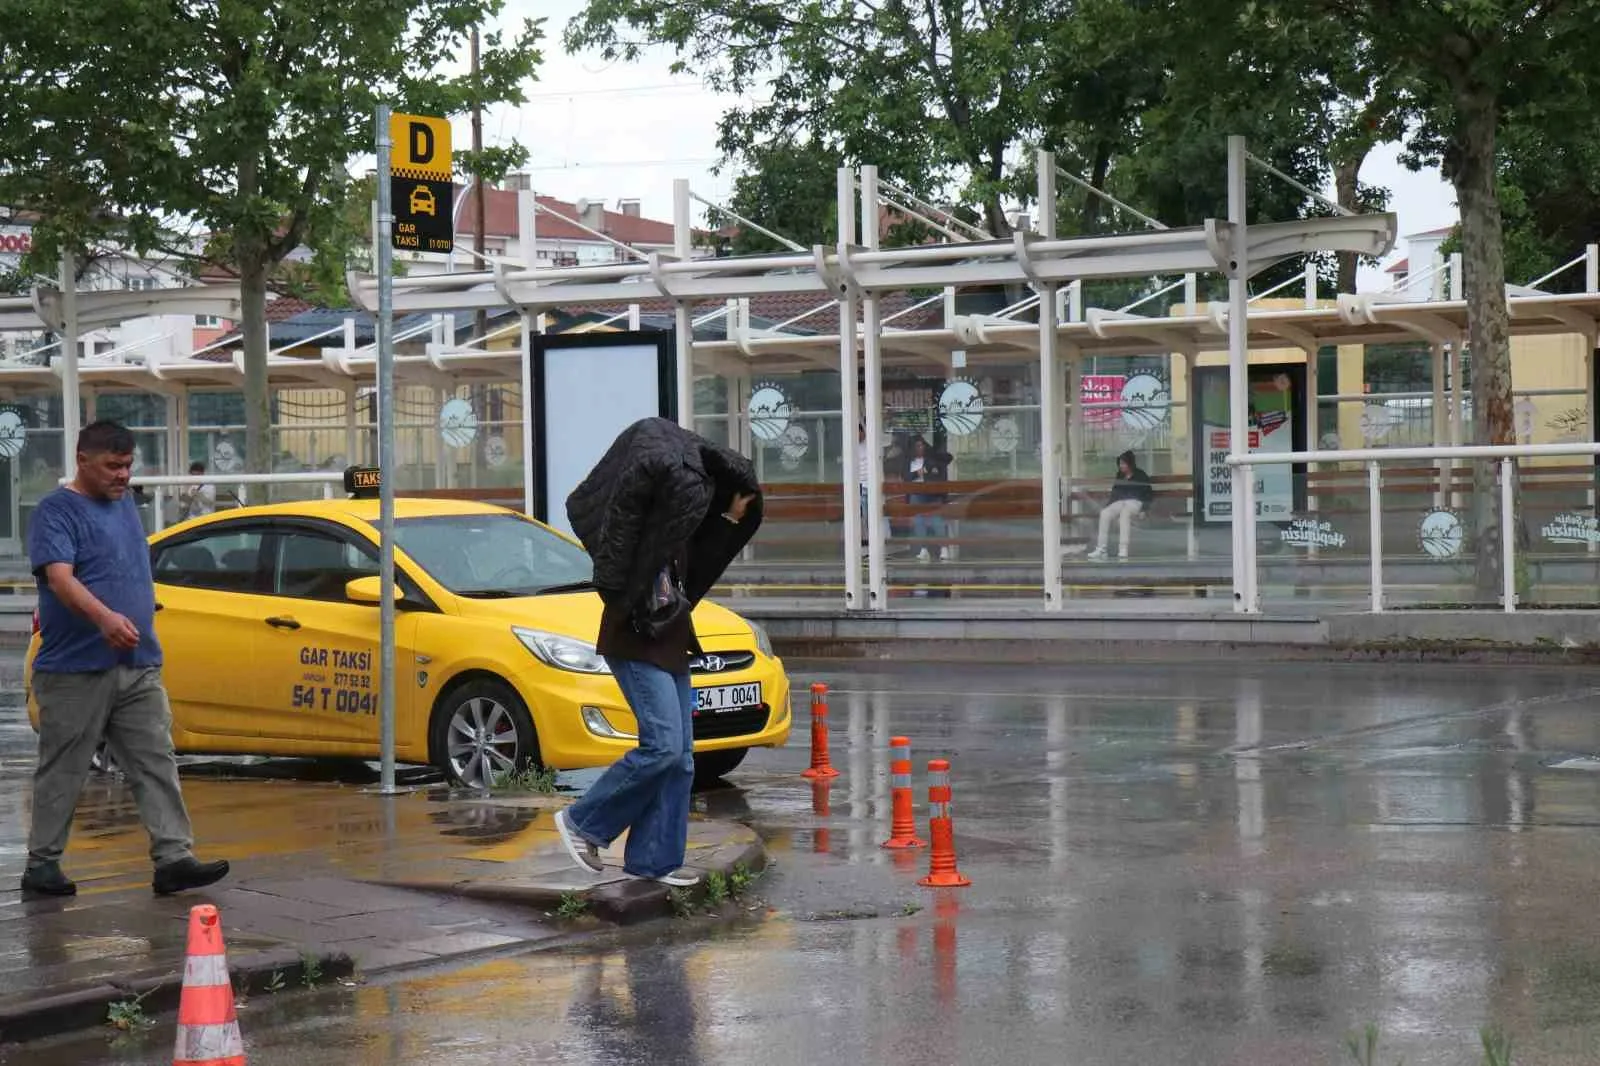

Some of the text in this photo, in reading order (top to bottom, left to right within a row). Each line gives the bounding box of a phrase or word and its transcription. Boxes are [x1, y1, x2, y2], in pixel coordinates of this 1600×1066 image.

[410, 122, 434, 164] D
[398, 223, 416, 233] GAR
[356, 473, 381, 485] TAKS
[1210, 466, 1232, 480] SPO
[300, 646, 371, 671] GAR TAKSİ
[292, 685, 378, 715] 54 T 0041
[698, 686, 757, 707] 54 T 0041
